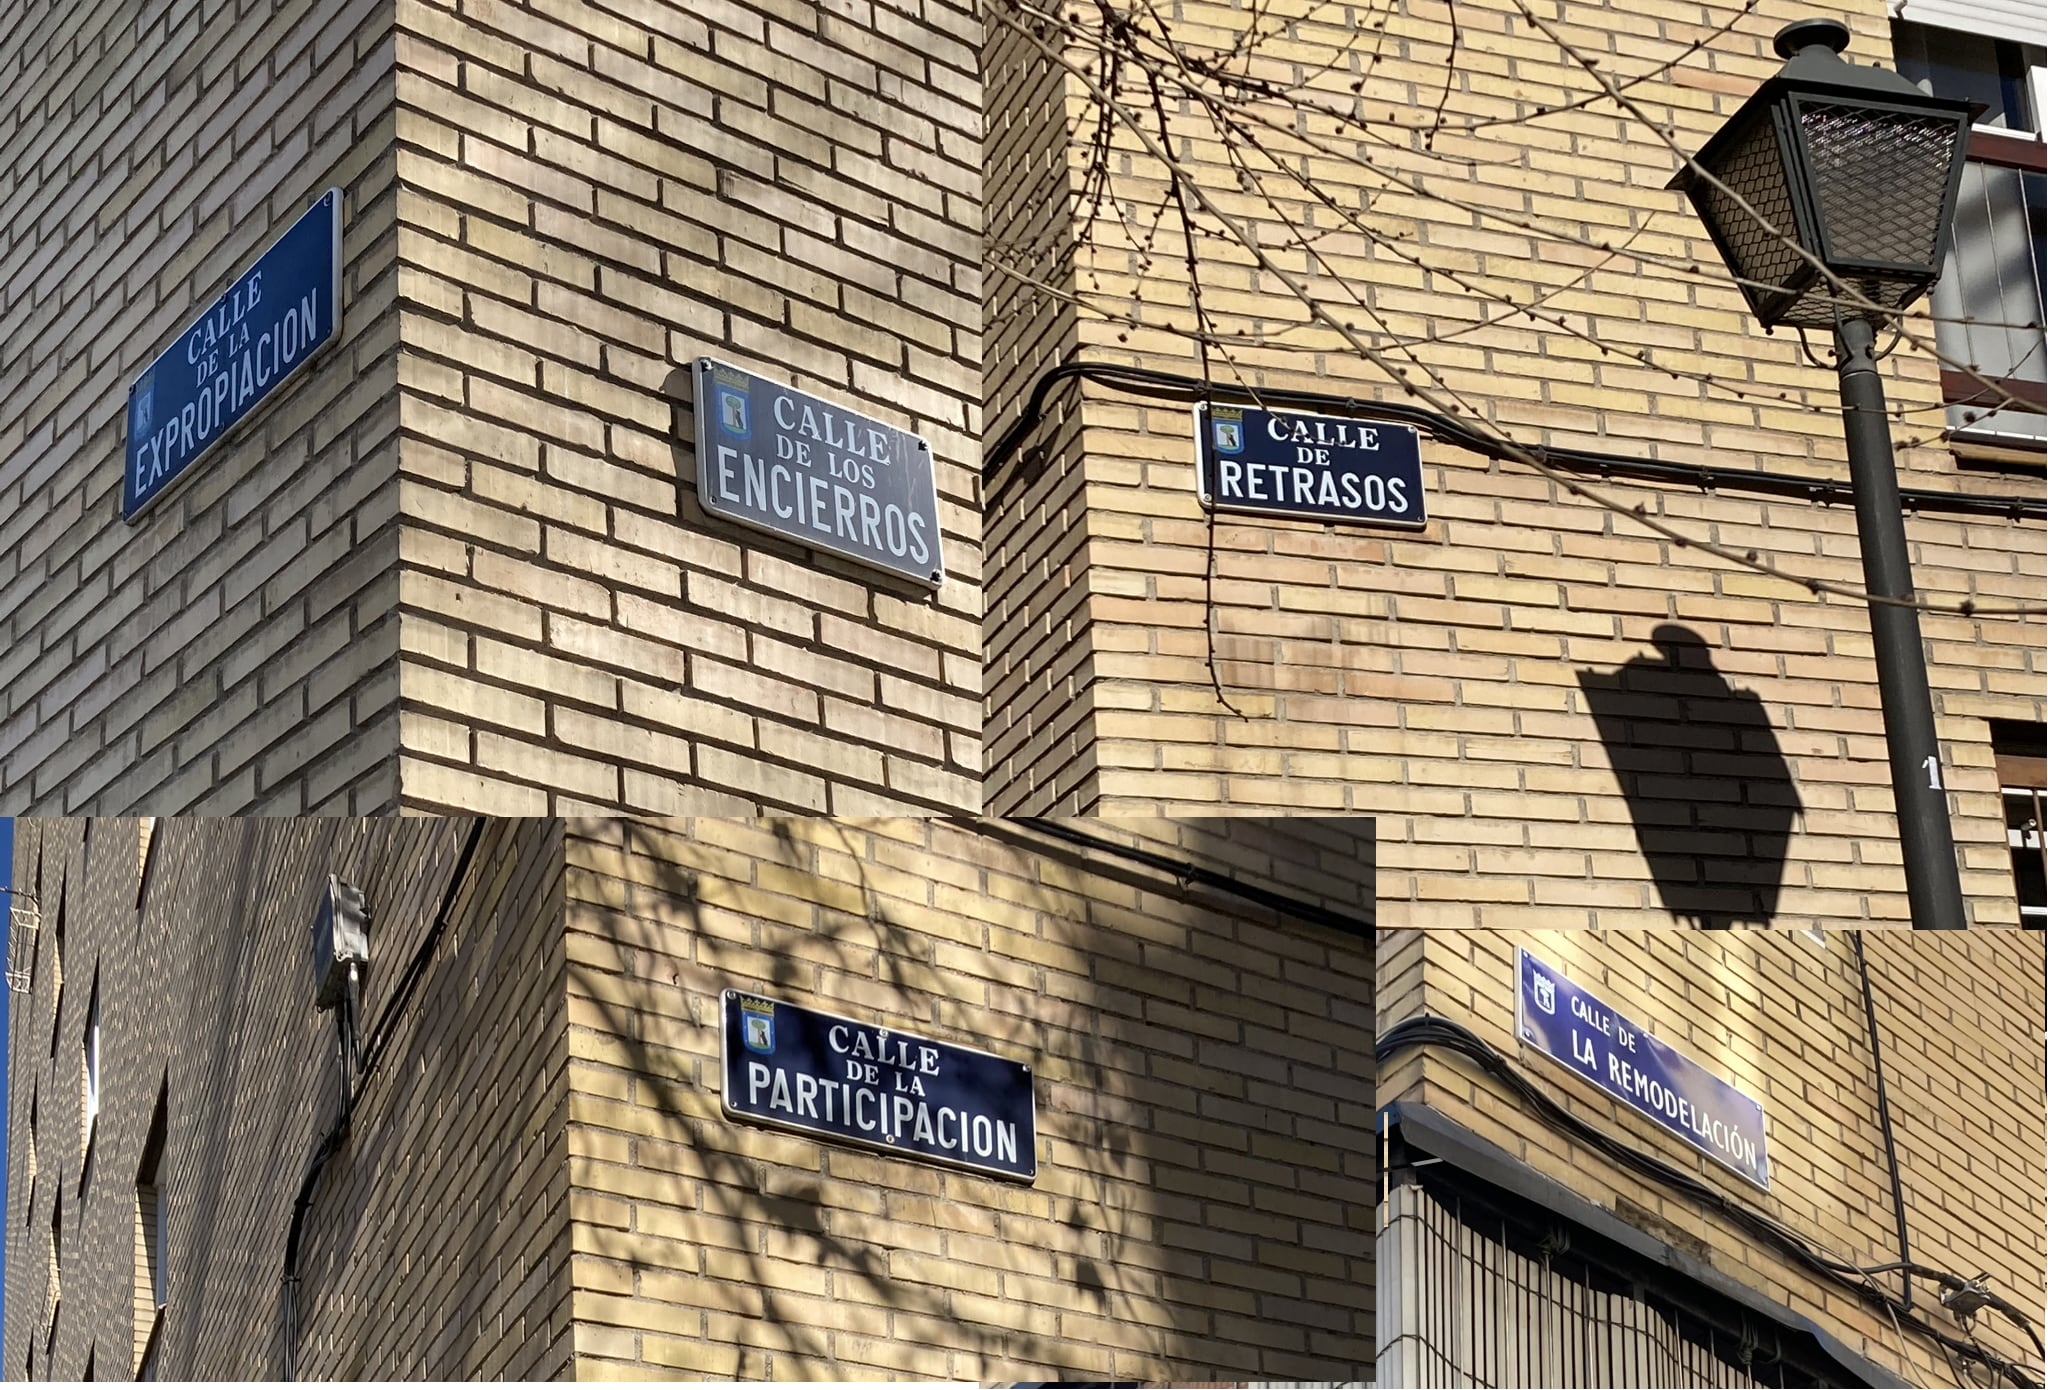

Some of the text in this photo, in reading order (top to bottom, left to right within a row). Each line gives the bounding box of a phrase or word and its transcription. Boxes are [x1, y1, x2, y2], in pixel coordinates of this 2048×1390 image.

[187, 270, 262, 365] CALLE
[196, 323, 250, 388] DE LA
[134, 287, 317, 499] EXPROPIACION
[773, 395, 891, 466] CALLE
[776, 434, 876, 489] DE LOS
[1267, 417, 1380, 451] CALLE
[1296, 446, 1331, 466] DE
[717, 444, 930, 565] ENCIERROS
[1219, 460, 1409, 513] RETRASOS
[828, 1024, 940, 1077] CALLE
[1571, 995, 1637, 1054] CALLE DE
[846, 1059, 926, 1097] DE LA
[1571, 1029, 1758, 1170] LA REMODELACIÓN
[748, 1061, 1018, 1164] PARTICIPACION
